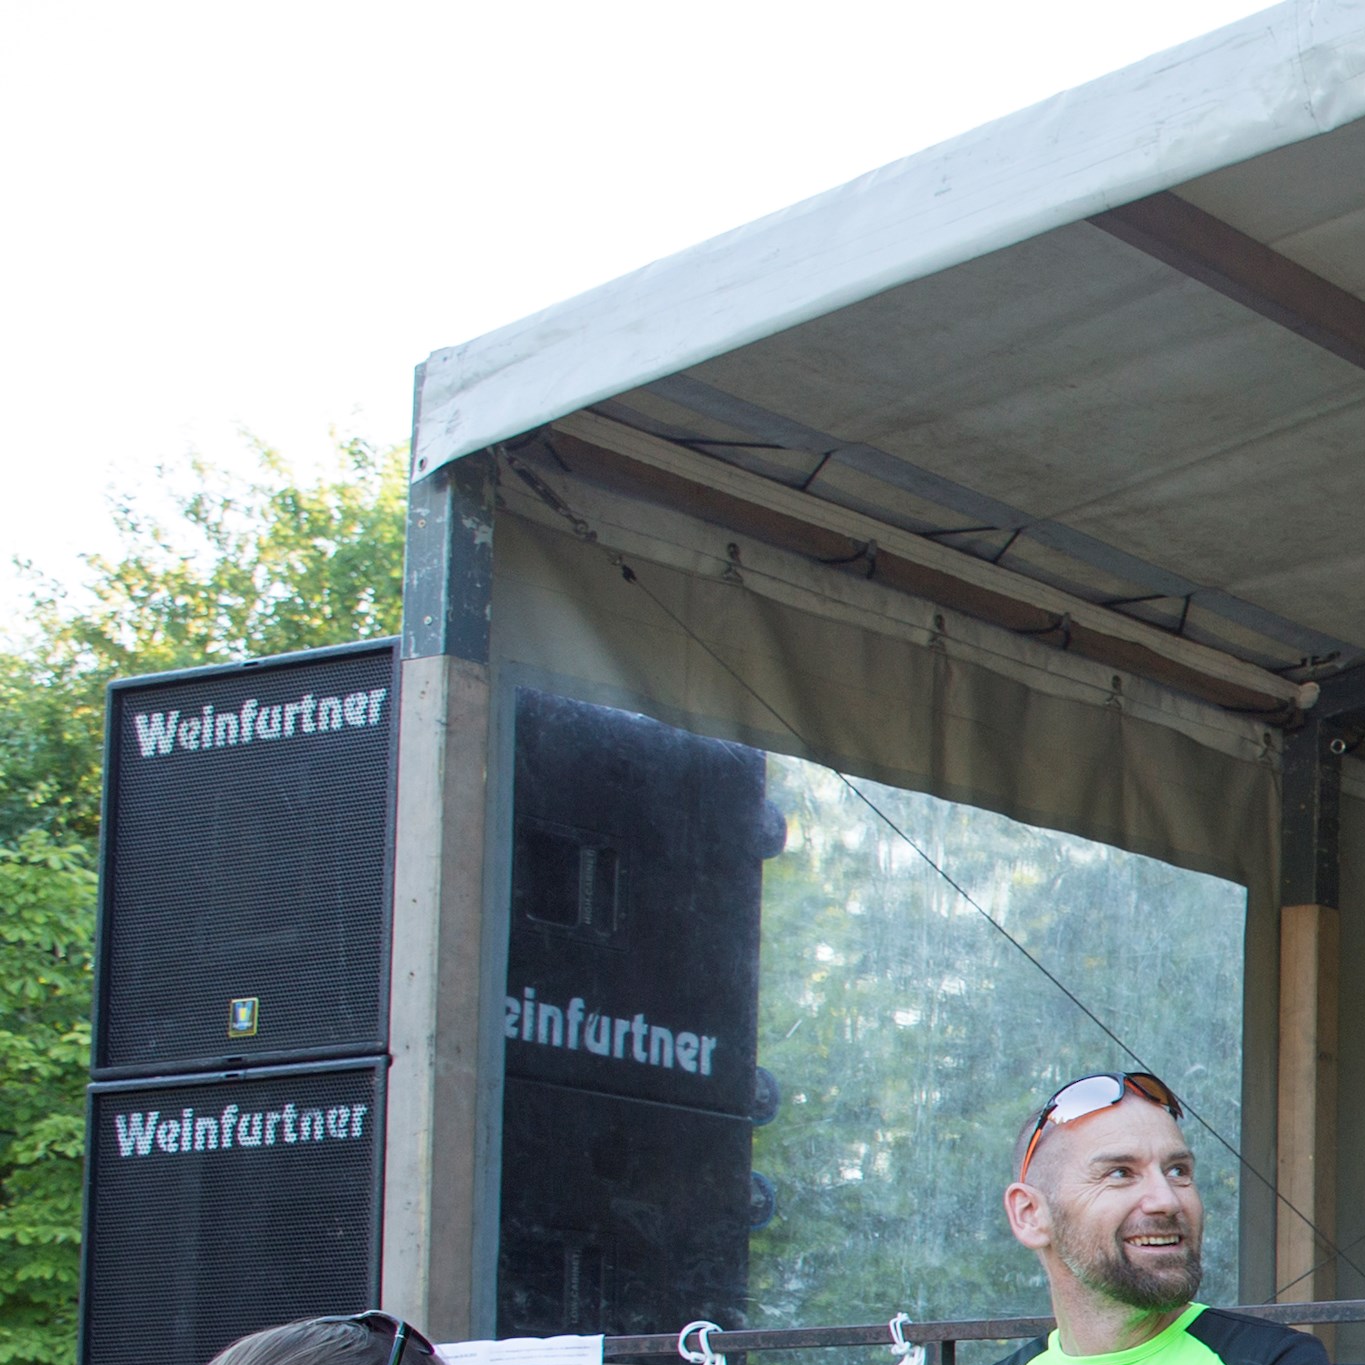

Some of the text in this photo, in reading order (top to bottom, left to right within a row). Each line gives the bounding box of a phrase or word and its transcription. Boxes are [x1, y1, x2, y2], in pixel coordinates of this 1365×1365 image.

[133, 688, 387, 757] Weinfurtner
[504, 986, 717, 1077] einfurtner
[115, 1103, 367, 1157] Weinfurtner
